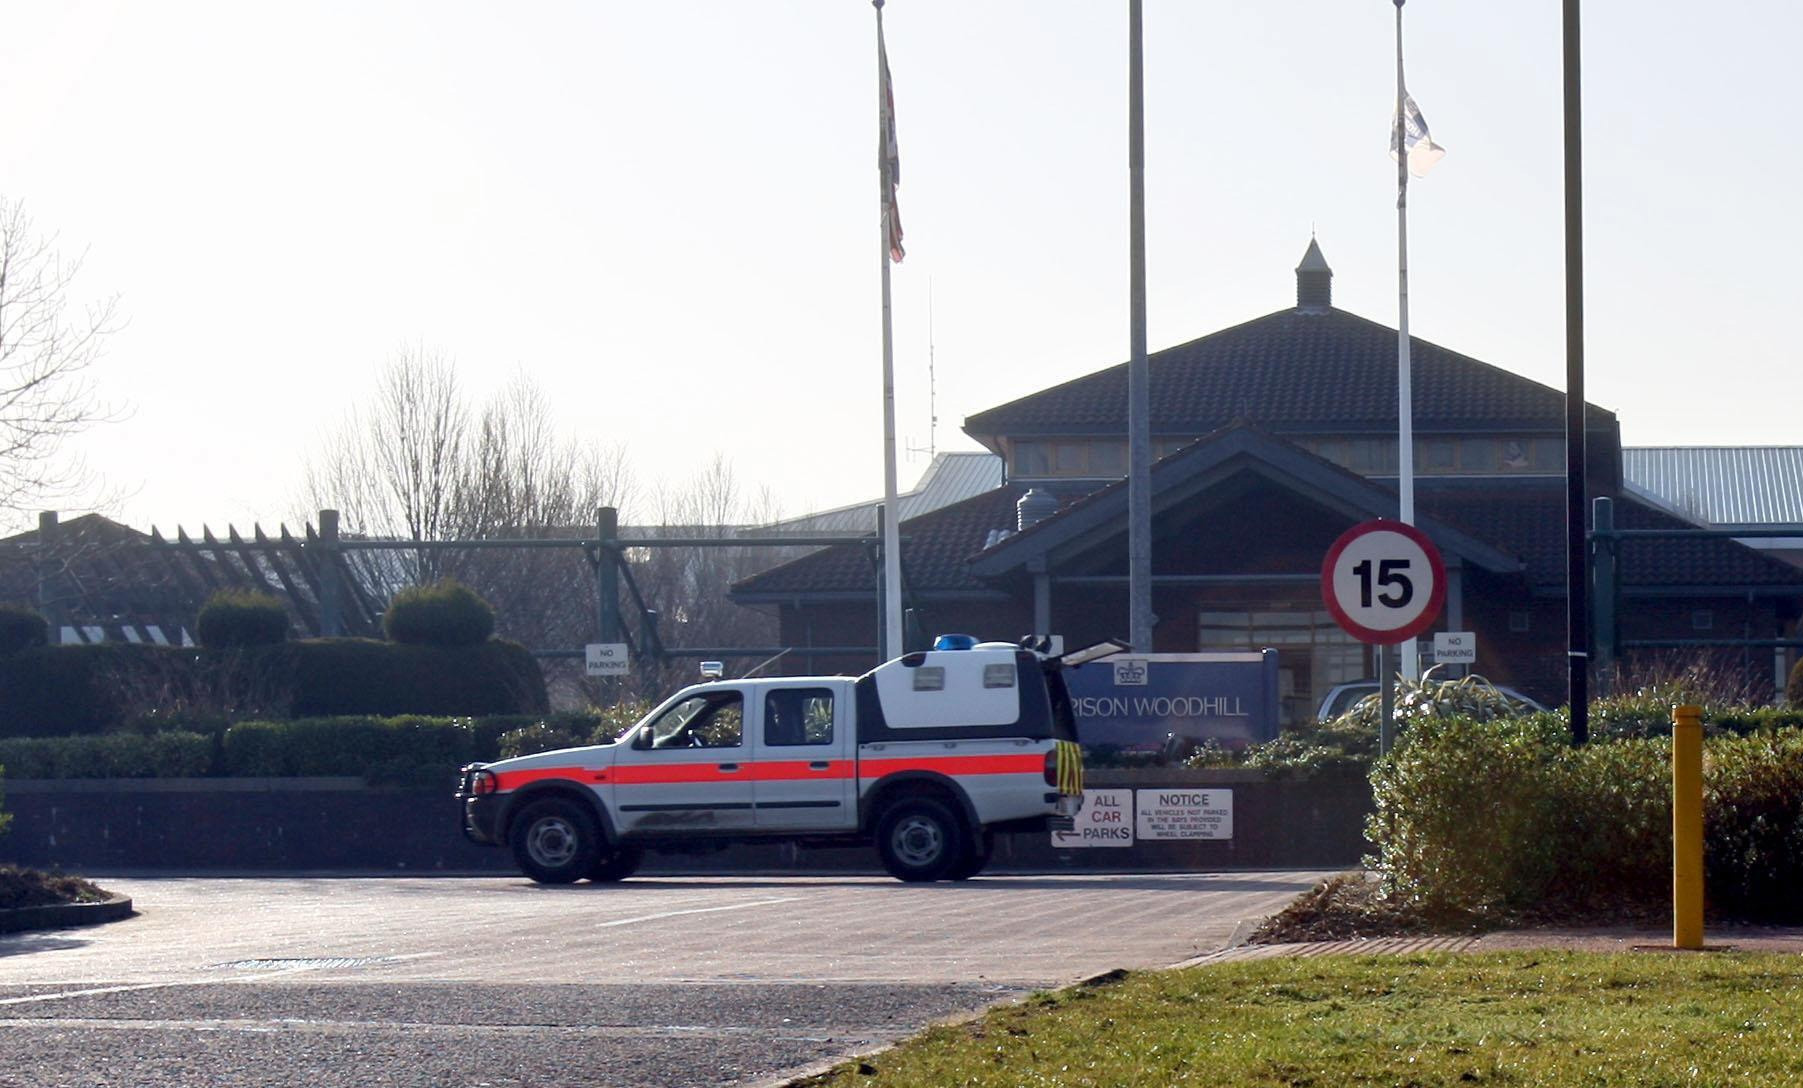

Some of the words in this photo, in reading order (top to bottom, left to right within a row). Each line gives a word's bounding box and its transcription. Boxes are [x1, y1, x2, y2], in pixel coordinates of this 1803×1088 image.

[1352, 559, 1414, 609] 15
[1448, 637, 1462, 646] NO
[600, 649, 614, 657] NO
[1437, 649, 1473, 657] PARKING
[589, 661, 626, 669] PARKING
[1071, 697, 1128, 717] RISON
[1134, 697, 1249, 717] WOODHILL
[1094, 795, 1120, 807] ALL
[1159, 794, 1209, 806] NOTICE
[1091, 811, 1121, 823] CAR
[1083, 827, 1130, 839] PARKS
